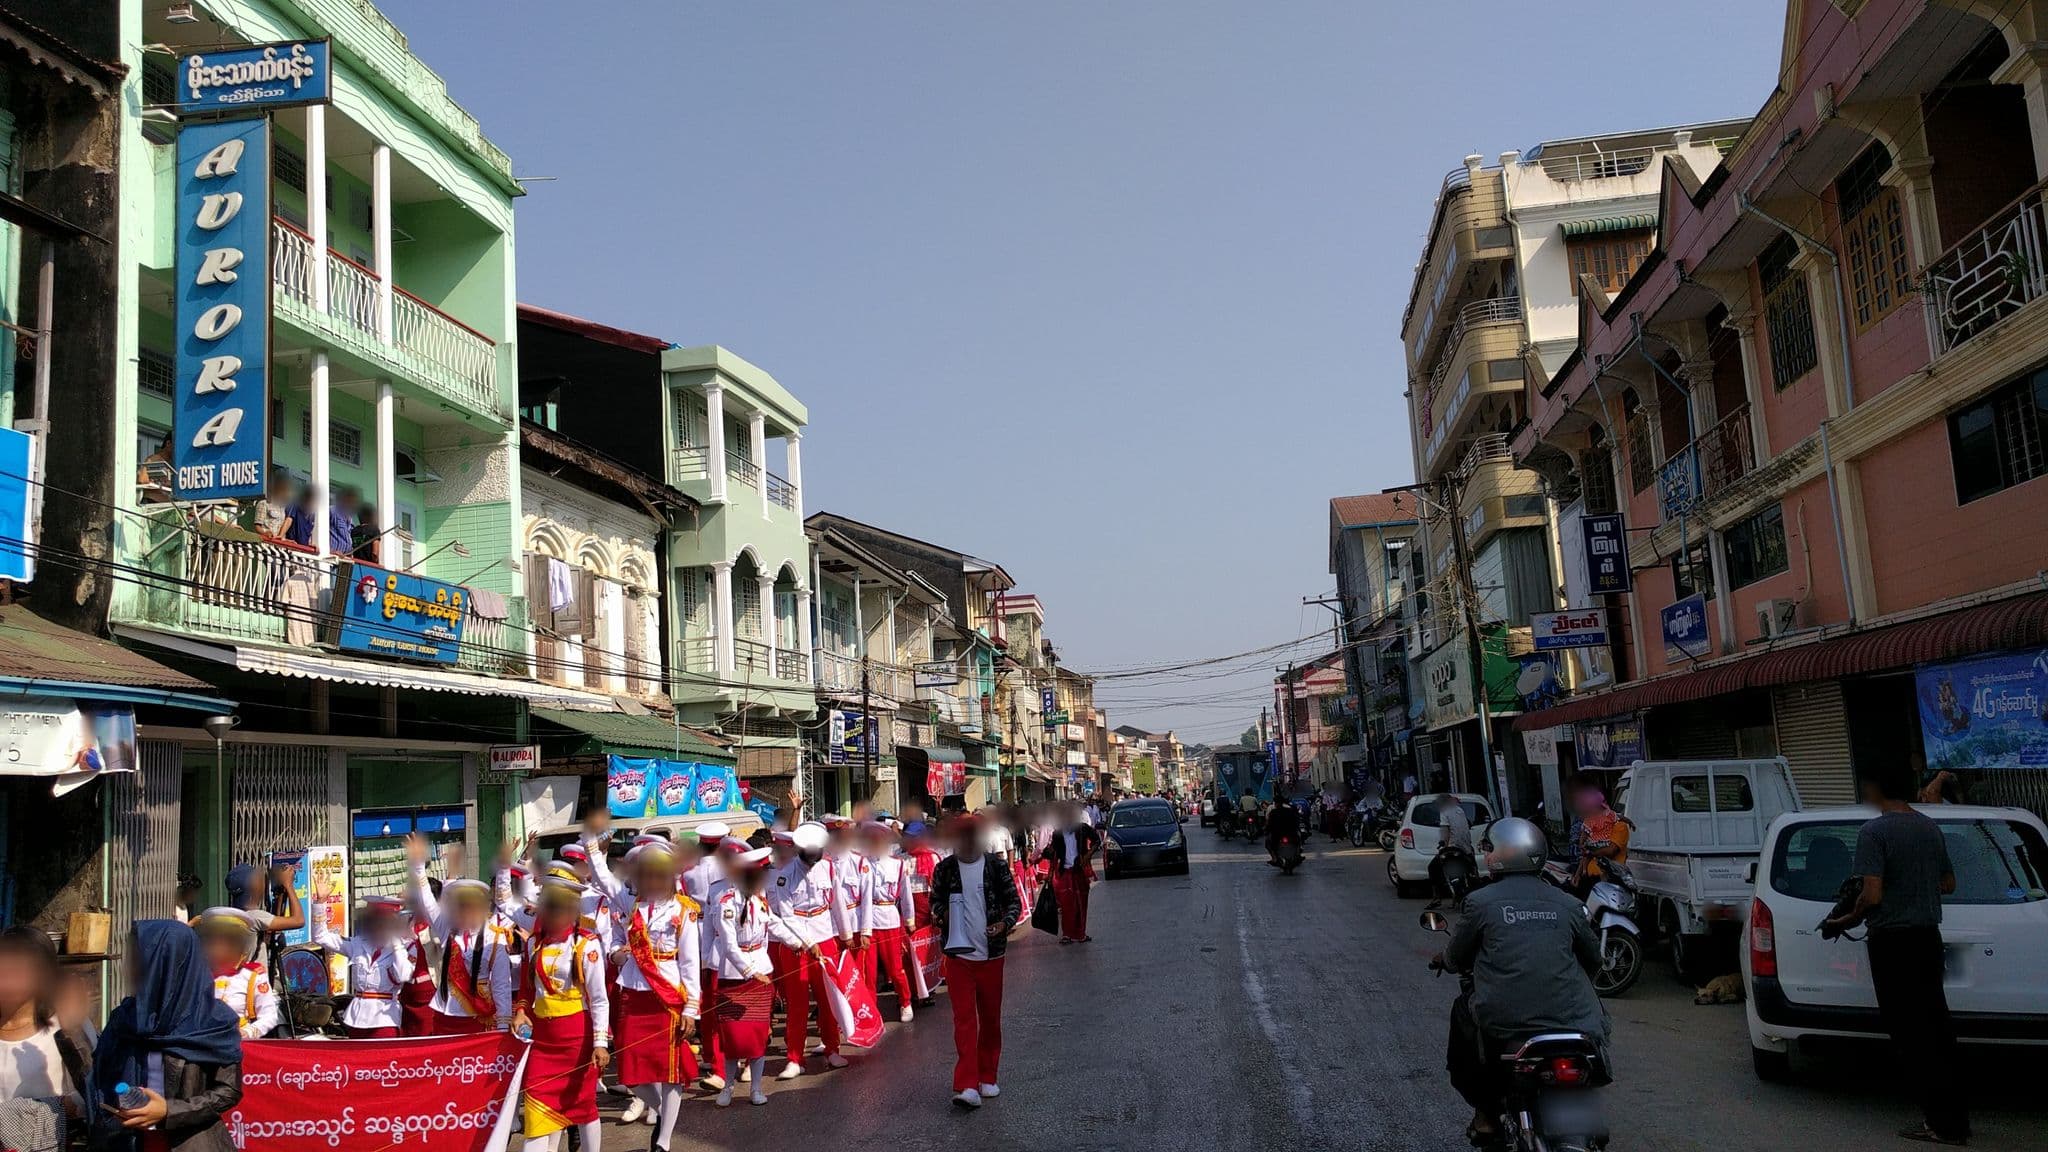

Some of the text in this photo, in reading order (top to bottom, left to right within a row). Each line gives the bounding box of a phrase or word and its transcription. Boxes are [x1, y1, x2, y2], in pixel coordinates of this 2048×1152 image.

[188, 44, 314, 99] မိုးသောက်ပန်း
[193, 138, 246, 450] AURORA
[178, 460, 259, 491] GUEST HOUSE
[500, 750, 533, 762] AURORA
[242, 1055, 520, 1090] တား (ချောင်းဆုံ) အမည်သတ်မှတ်ခြင်းဆိုင်
